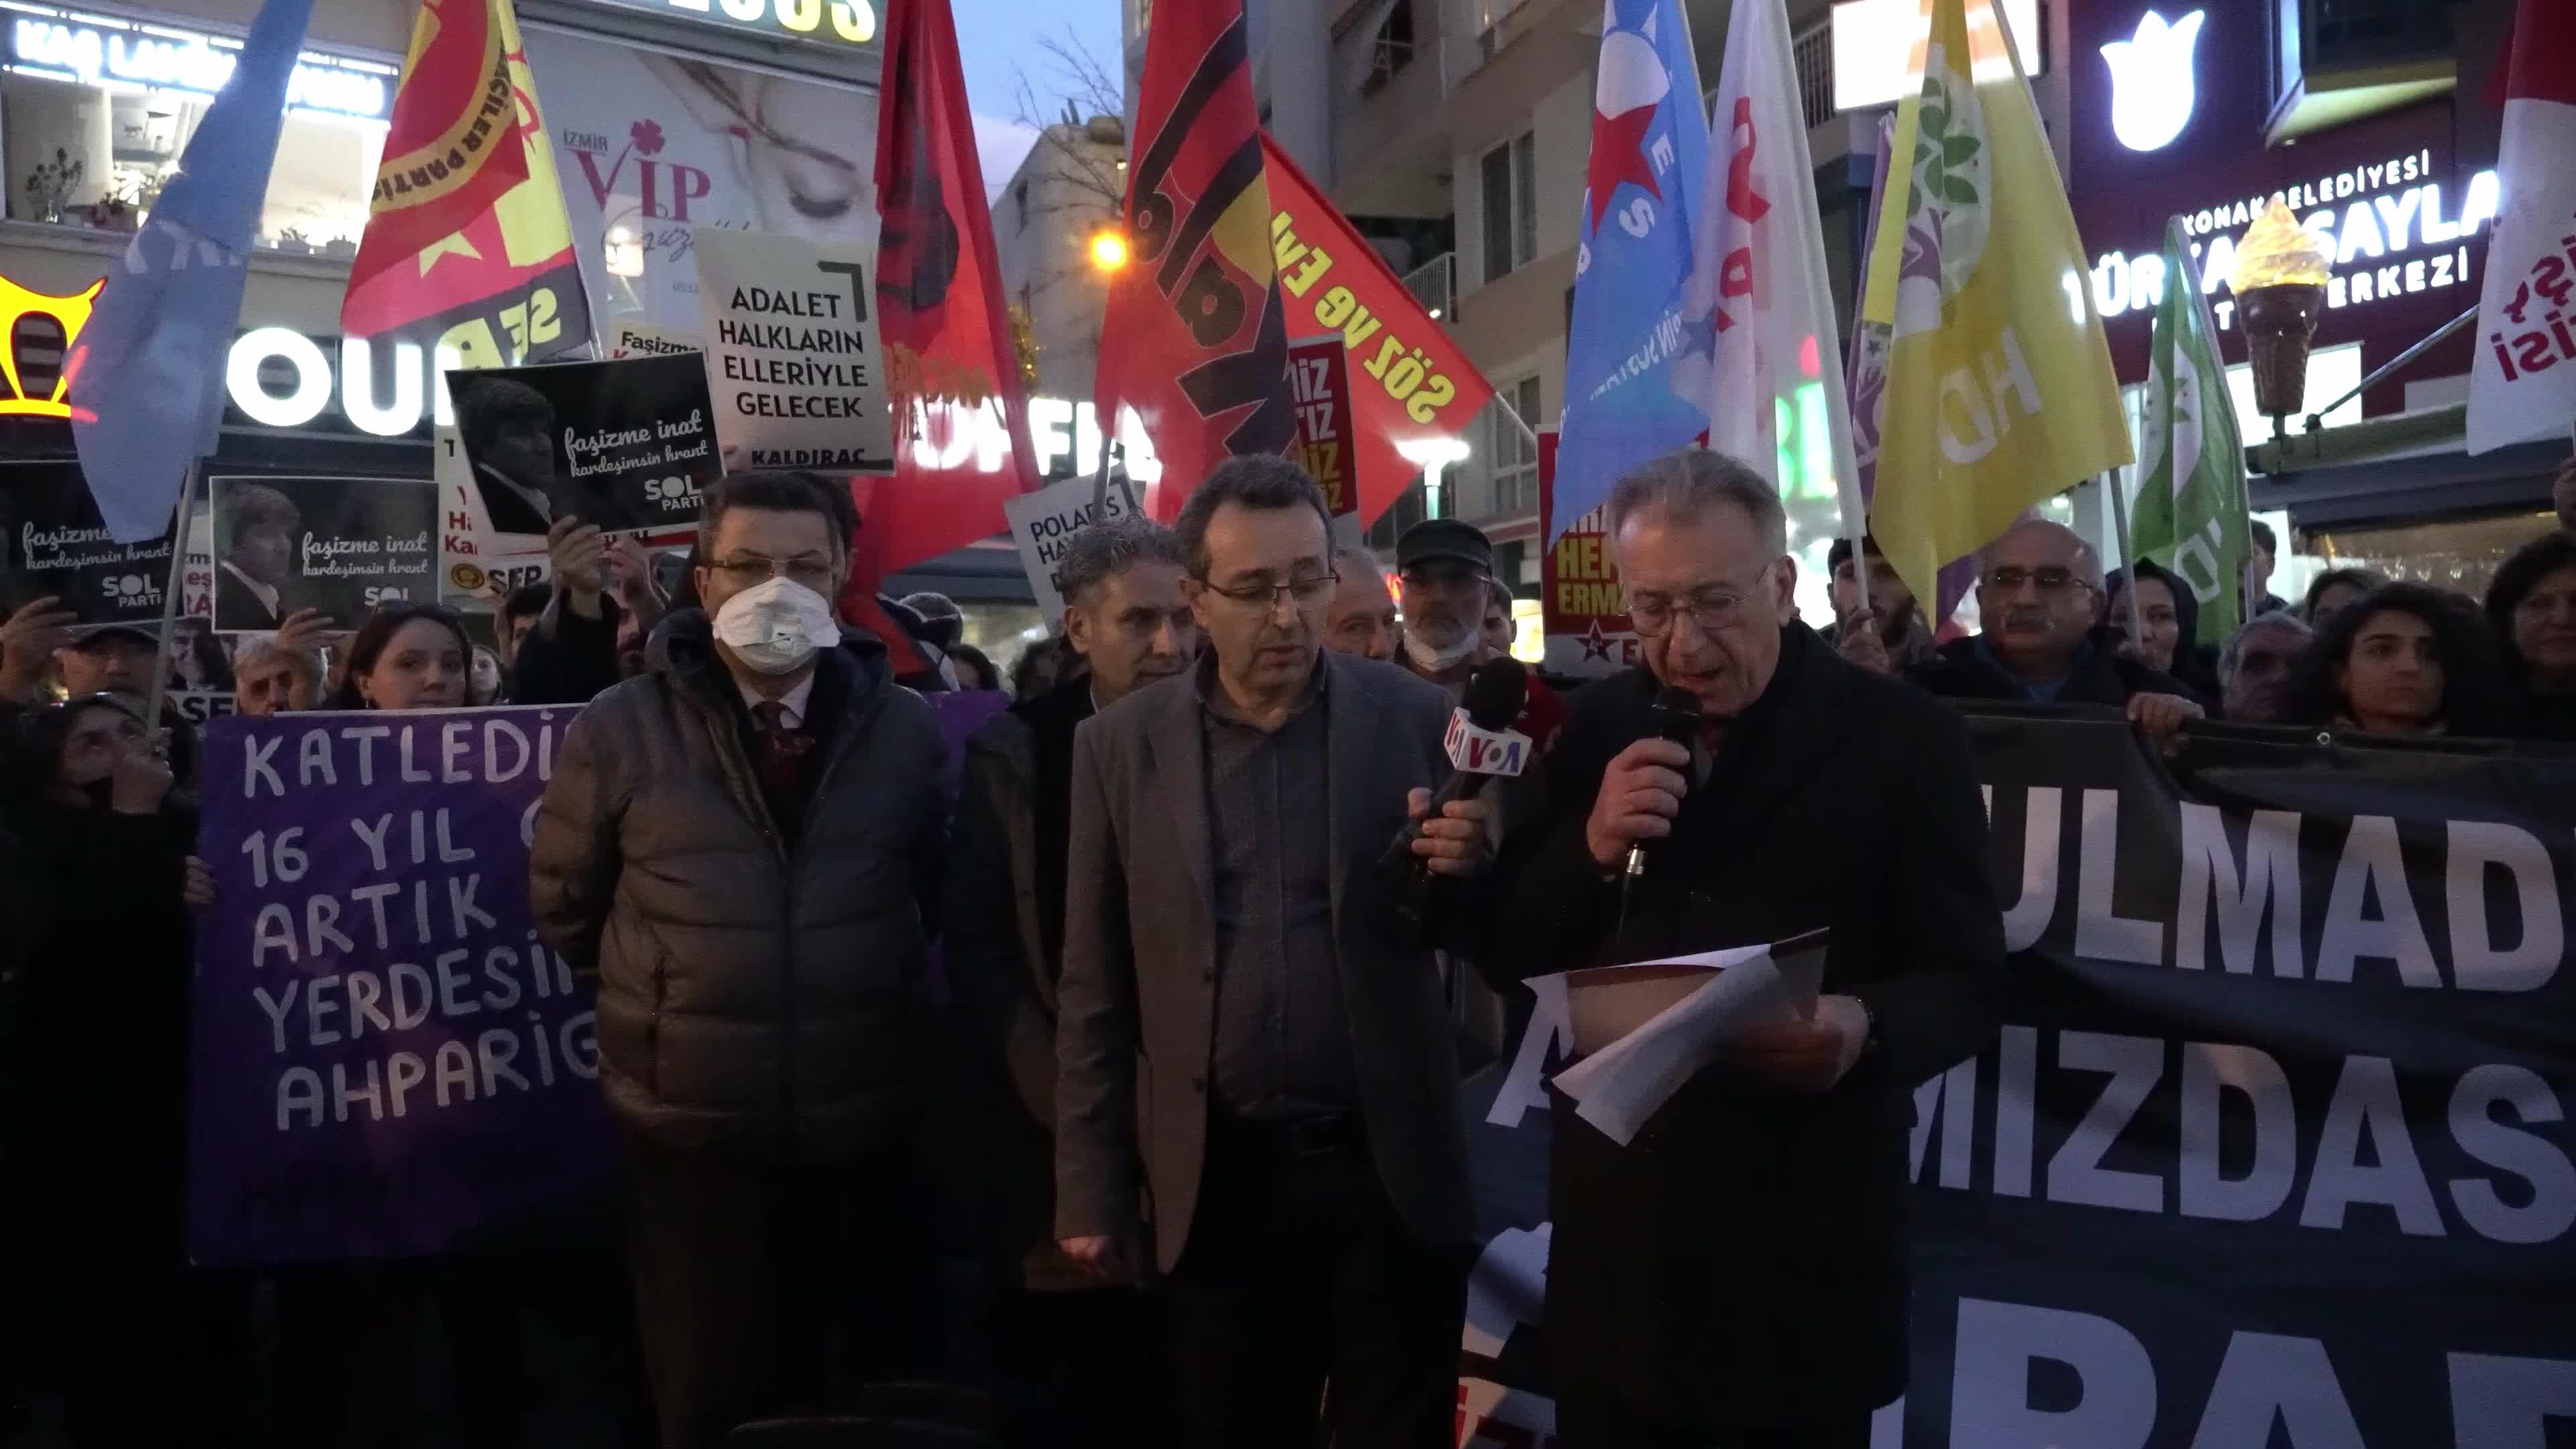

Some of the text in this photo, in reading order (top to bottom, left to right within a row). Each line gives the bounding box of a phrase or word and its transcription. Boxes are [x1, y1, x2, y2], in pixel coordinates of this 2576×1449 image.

[2327, 245, 2469, 309] ERKEZİ
[731, 287, 841, 318] ADALET
[621, 331, 698, 355] Faşizm
[718, 320, 864, 354] HALKLARIN
[724, 356, 868, 387] ELLERİYLE
[737, 391, 863, 419] GELECEK
[565, 409, 703, 462] faşizme inat
[570, 439, 708, 477] kardeşimsin hrant
[645, 475, 702, 500] SOL
[26, 551, 122, 570] kardeşimsin
[127, 541, 172, 561] hrant
[302, 531, 428, 559] faşizme inat
[303, 558, 428, 578] kardeşimsin hrant
[102, 574, 160, 597] SOL
[244, 712, 567, 798] KATLEDİ
[1469, 737, 1521, 773] VOA
[241, 826, 309, 888] 16
[350, 807, 476, 871] YIL
[254, 873, 497, 967] ARTIK
